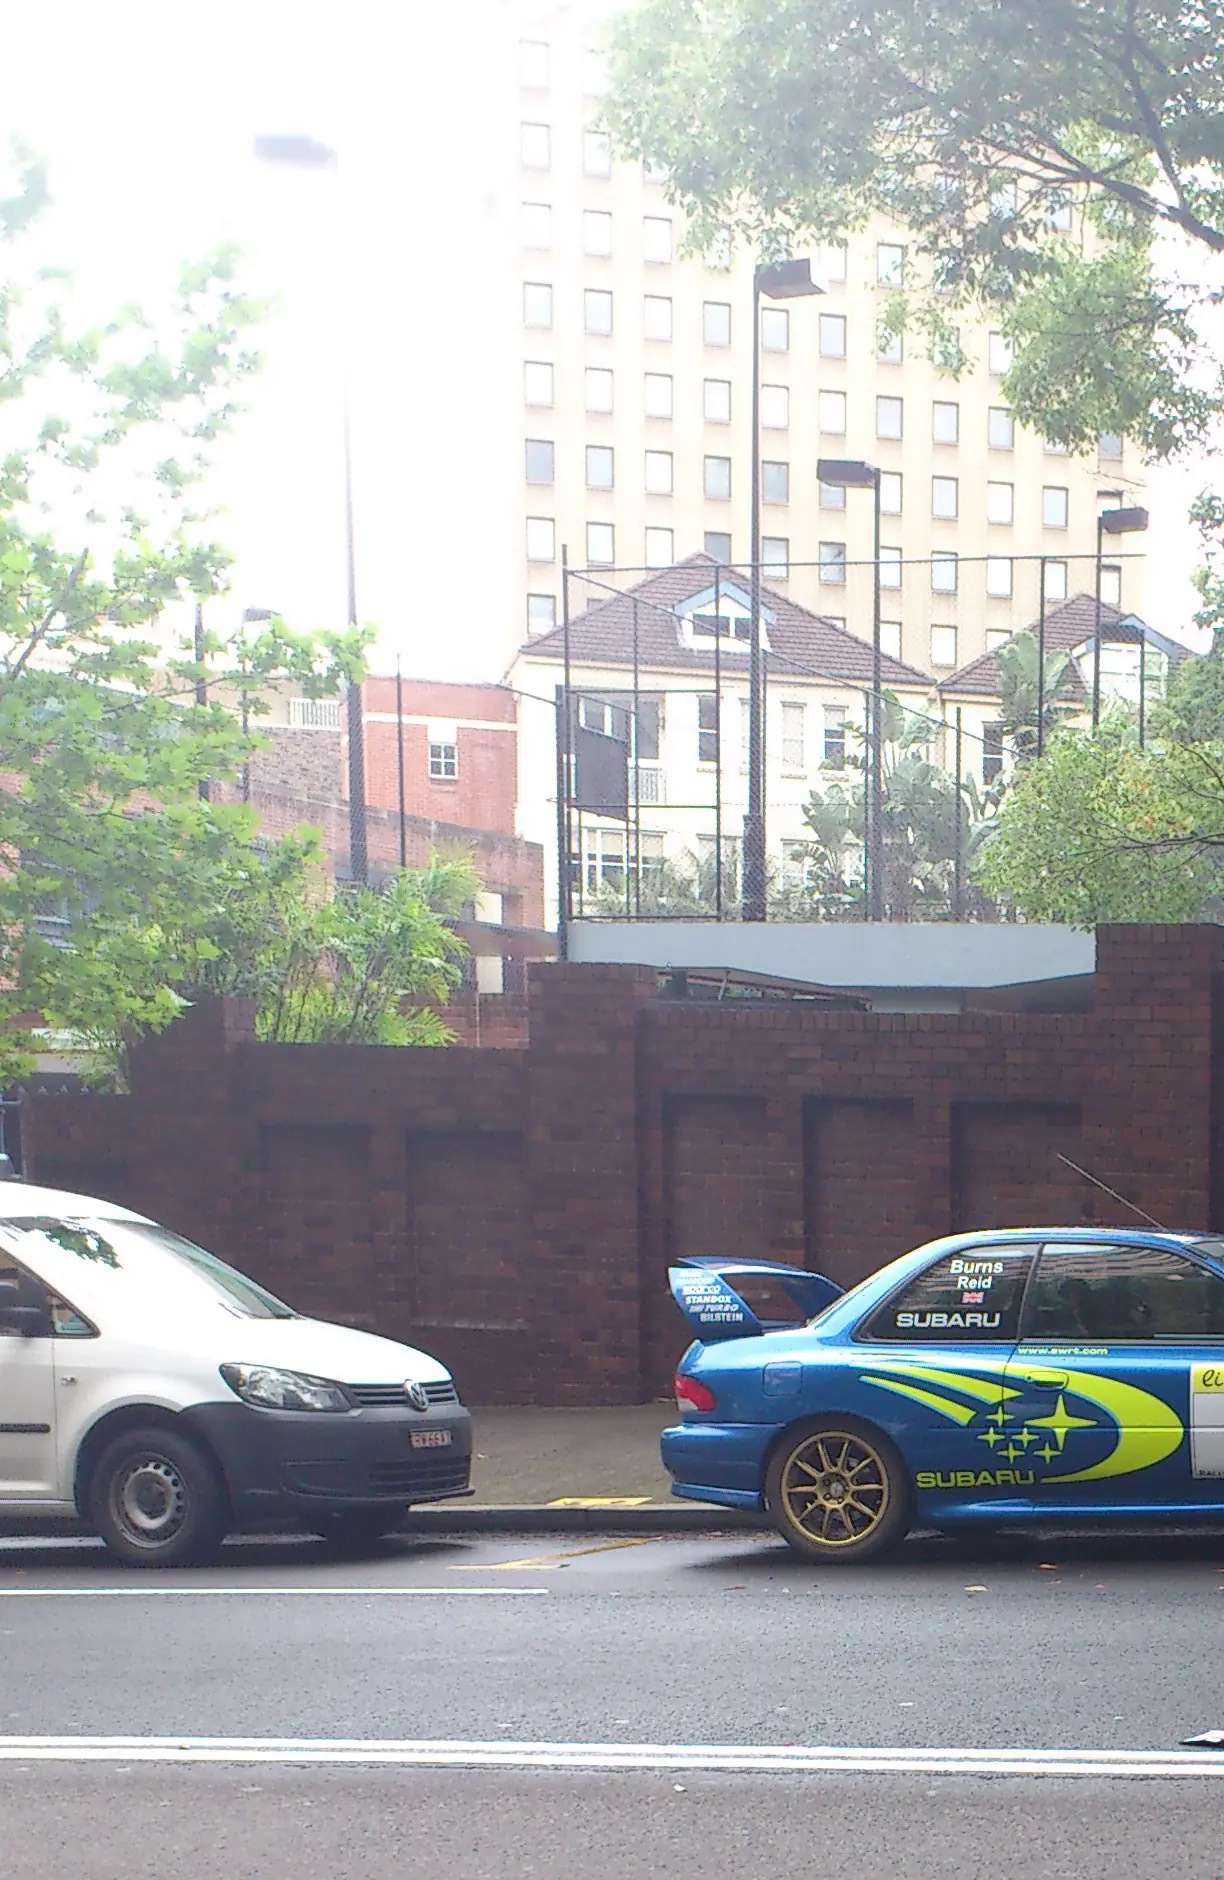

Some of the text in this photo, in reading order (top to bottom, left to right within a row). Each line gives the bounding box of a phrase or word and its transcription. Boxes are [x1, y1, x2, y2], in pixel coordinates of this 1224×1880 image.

[950, 1260, 1004, 1274] Burns
[957, 1276, 993, 1289] Reid
[685, 1295, 732, 1304] STANDOX
[700, 1313, 744, 1323] BILSTEIN
[896, 1312, 1001, 1328] SUBARU
[916, 1469, 1036, 1488] SUBARU
